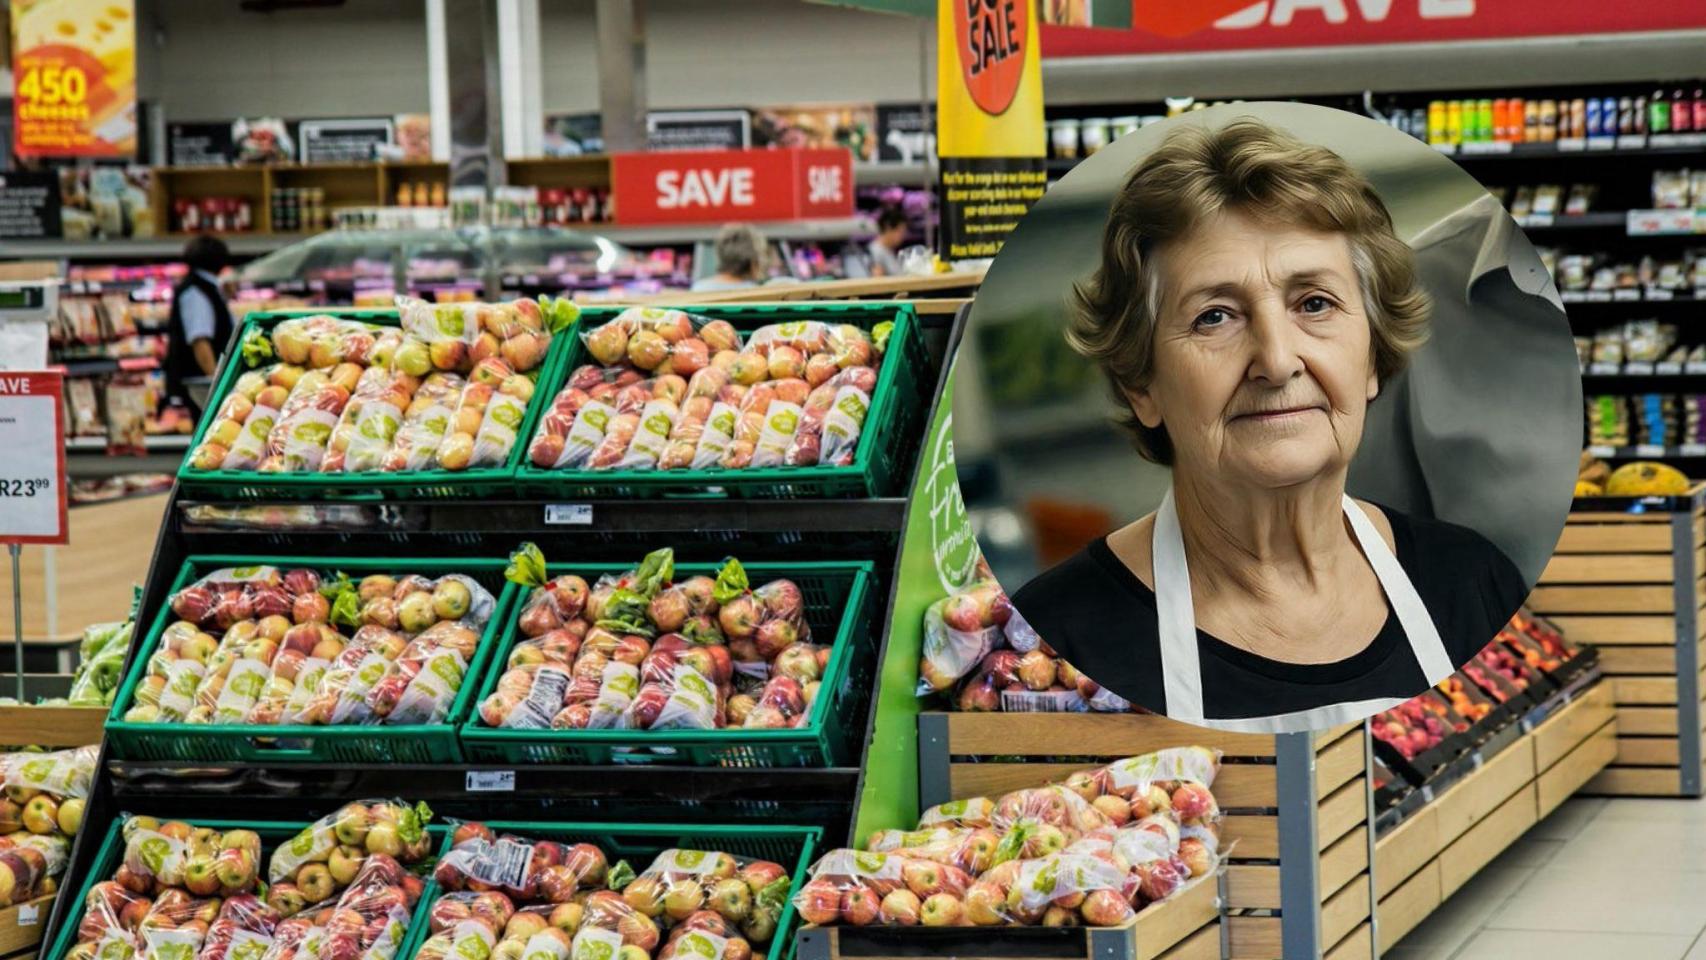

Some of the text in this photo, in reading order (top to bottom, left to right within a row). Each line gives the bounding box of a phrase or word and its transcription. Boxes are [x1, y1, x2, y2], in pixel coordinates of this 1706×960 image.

[969, 3, 1019, 75] SALE
[18, 66, 87, 106] 450
[656, 167, 754, 209] SAVE
[807, 165, 843, 204] SAVE
